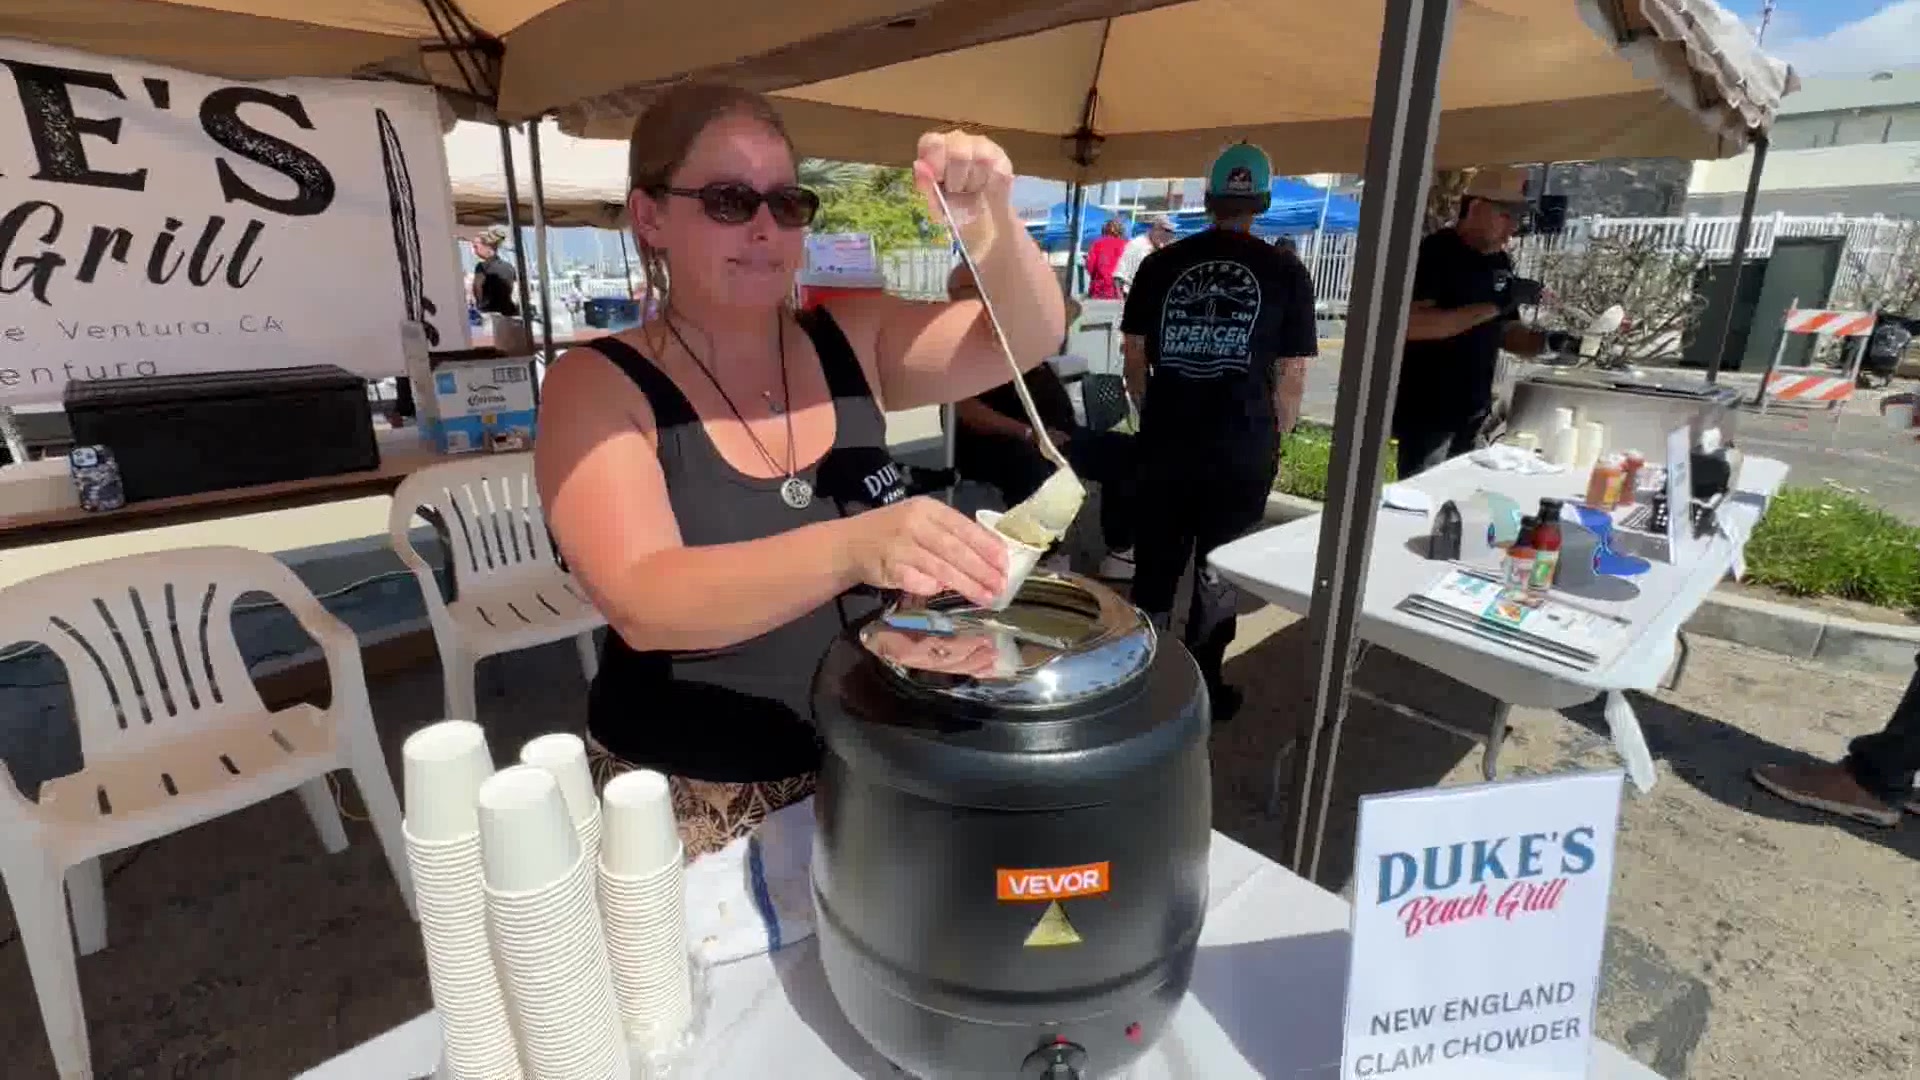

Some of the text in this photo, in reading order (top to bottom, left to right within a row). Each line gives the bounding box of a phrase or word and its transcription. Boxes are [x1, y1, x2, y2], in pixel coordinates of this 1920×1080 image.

[0, 59, 335, 216] E'S
[0, 201, 265, 306] Grill
[239, 314, 284, 334] CA
[1165, 325, 1247, 344] SPENCER
[1008, 869, 1100, 895] VEVOR
[1376, 825, 1595, 905] DUKE'S
[1397, 878, 1568, 938] Beach Grill
[1370, 981, 1575, 1035] NEW ENGLAND
[1355, 1017, 1581, 1077] CLAM CHOWDER
